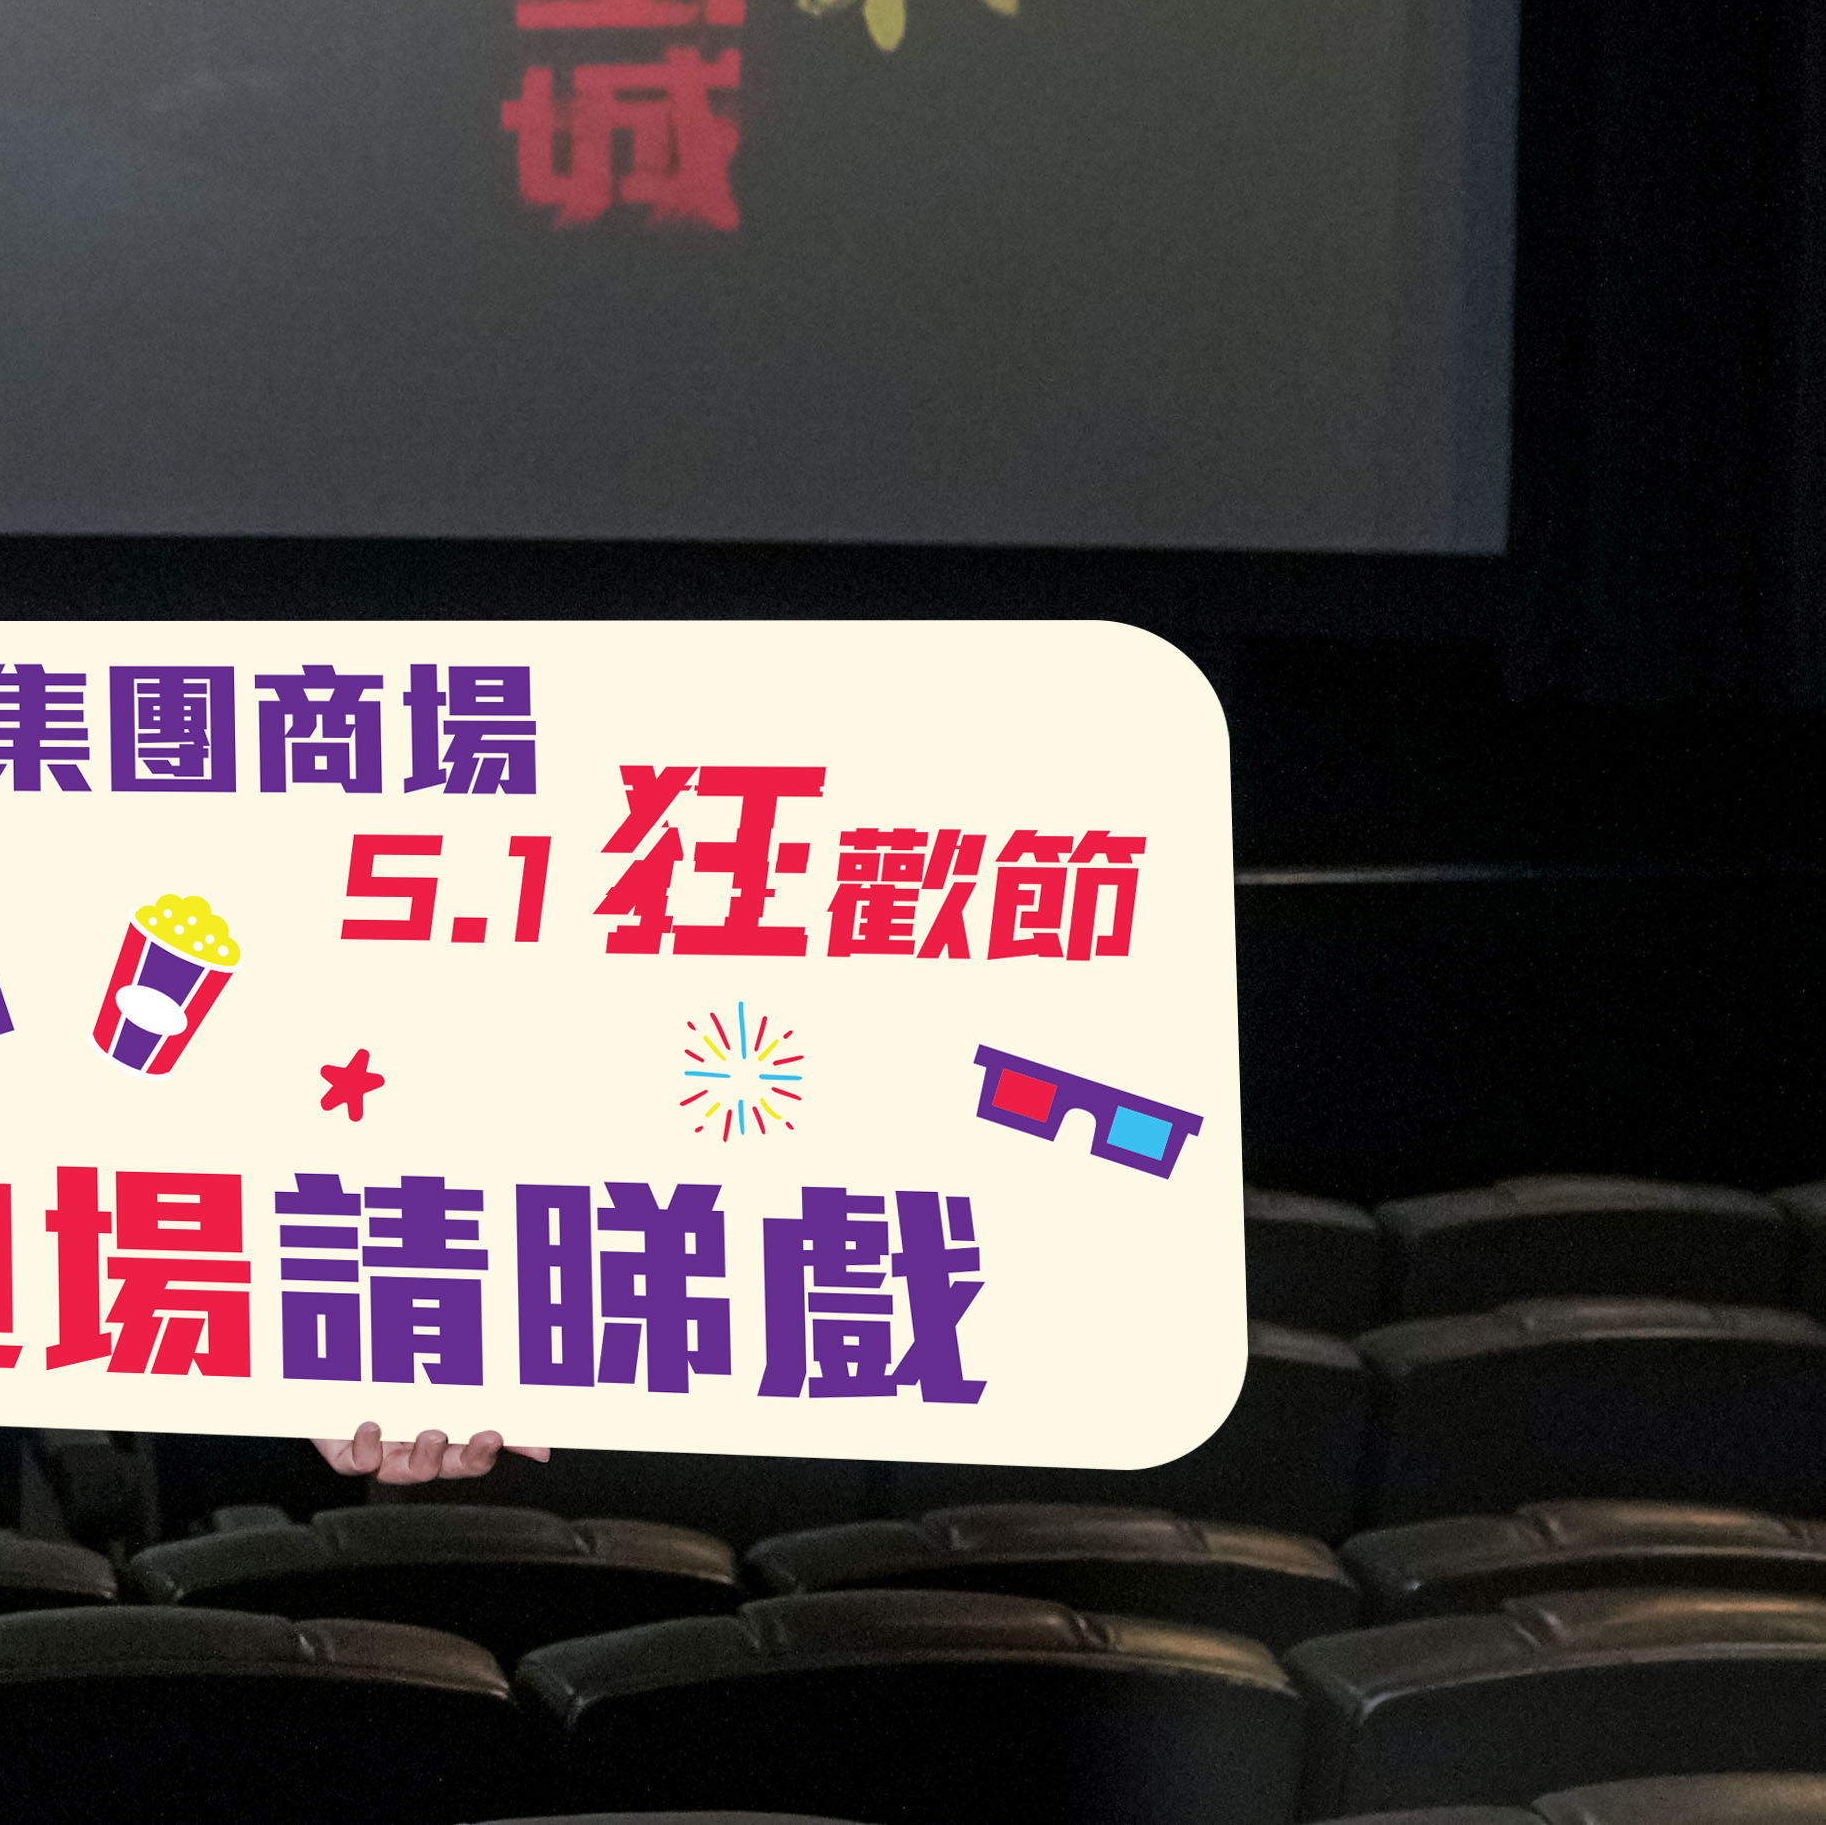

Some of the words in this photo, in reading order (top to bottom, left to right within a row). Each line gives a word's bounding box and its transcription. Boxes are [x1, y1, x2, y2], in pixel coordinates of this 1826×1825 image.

[340, 834, 552, 944] 5.1
[593, 765, 1147, 962] 狂歡節
